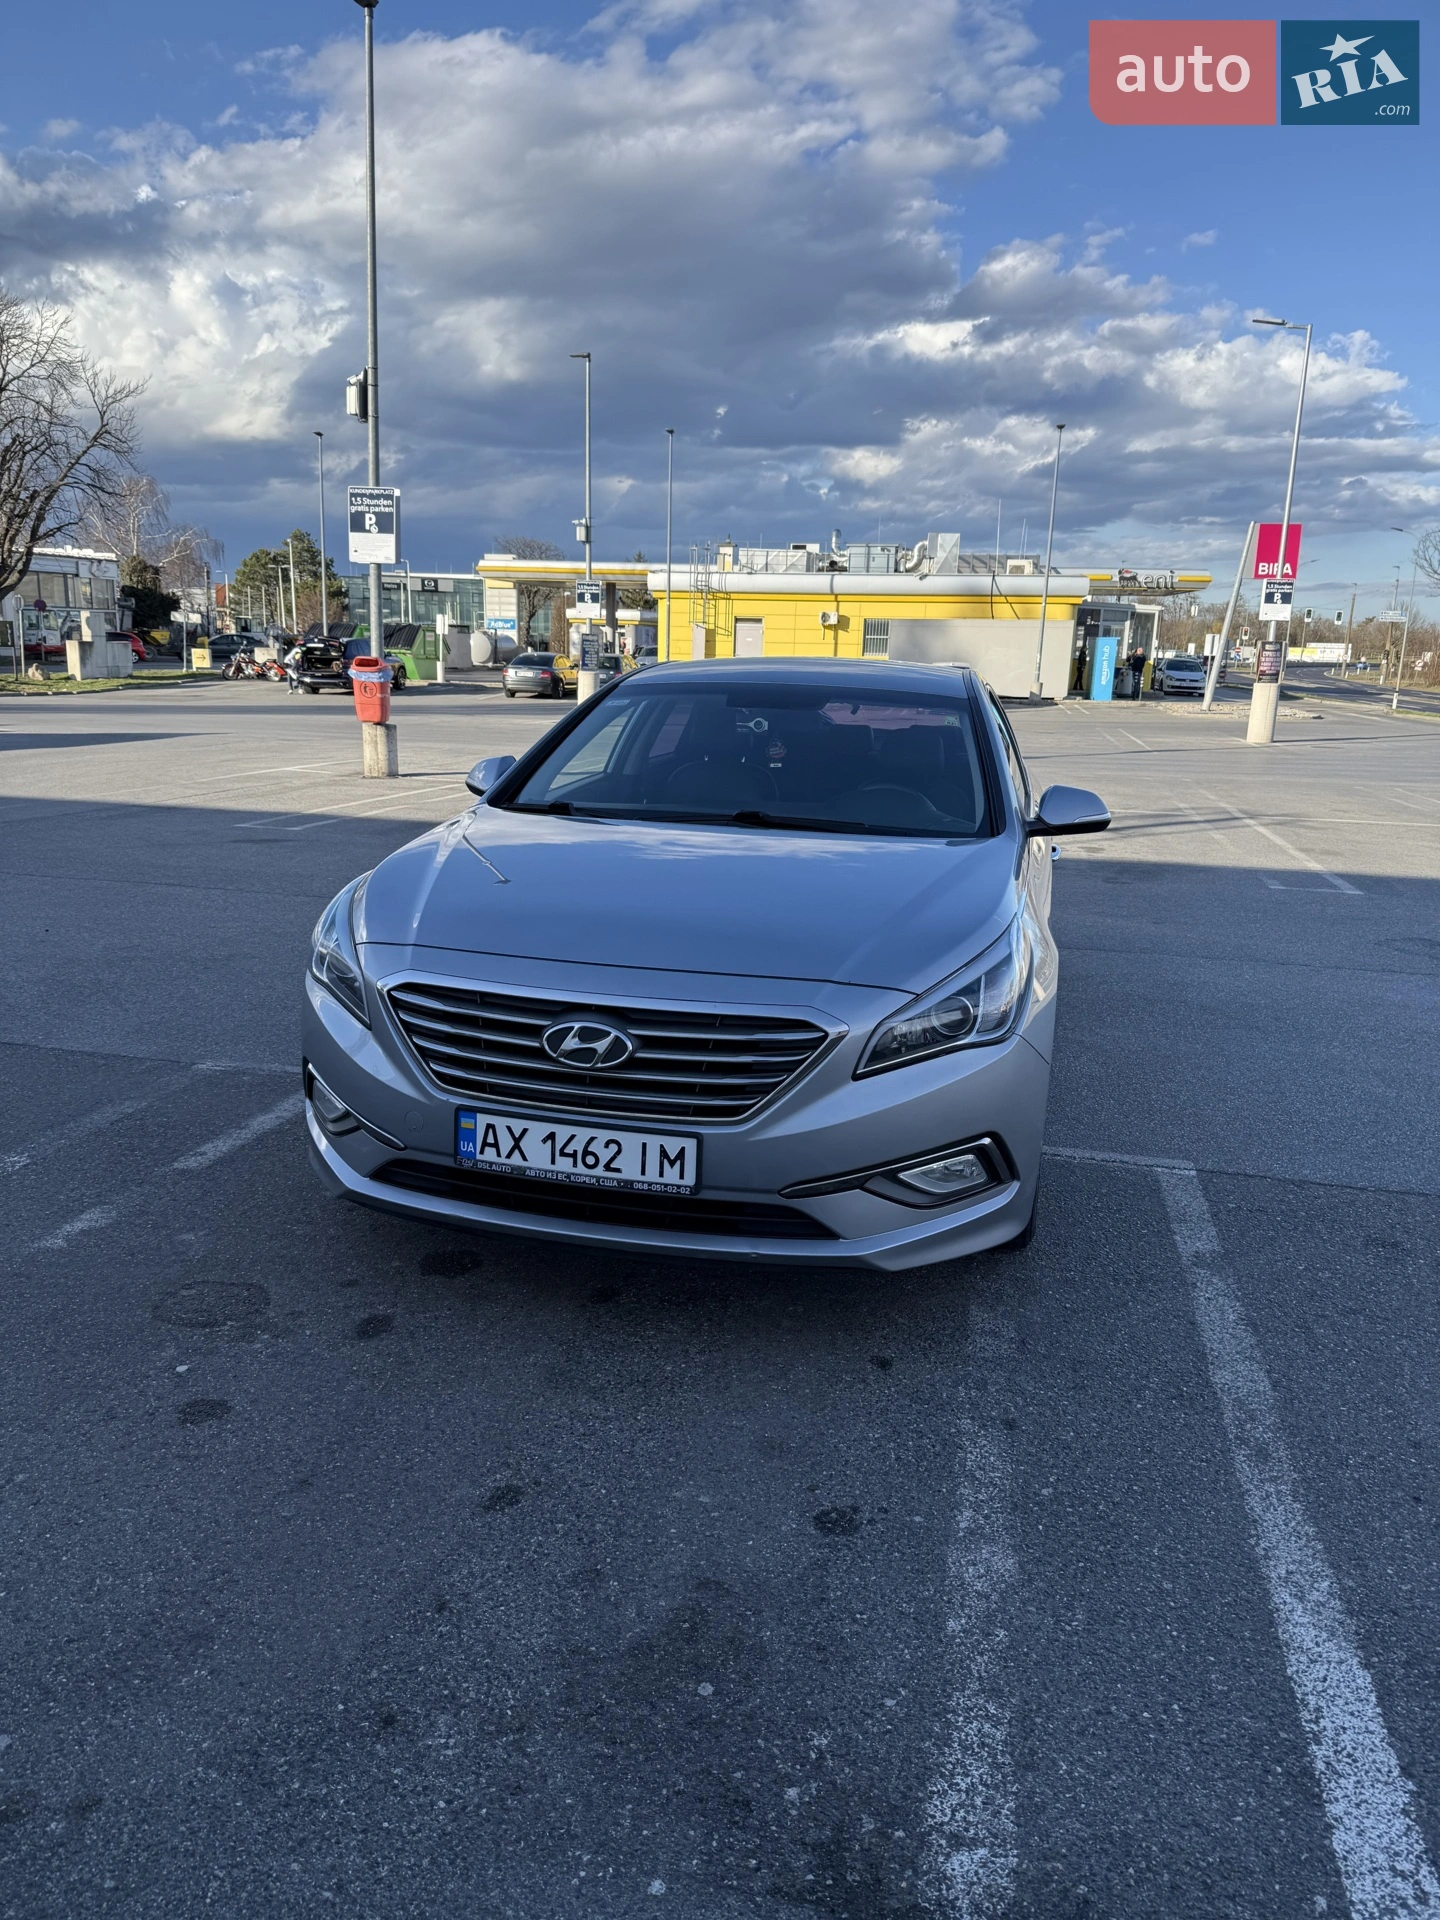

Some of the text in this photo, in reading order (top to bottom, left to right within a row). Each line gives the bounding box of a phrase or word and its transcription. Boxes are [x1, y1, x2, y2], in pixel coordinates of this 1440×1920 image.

[350, 505, 369, 513] gratis
[362, 498, 392, 506] Stunden
[365, 513, 376, 530] P
[1142, 570, 1175, 589] eni
[1101, 661, 1109, 685] amazon
[460, 1141, 475, 1153] UA
[479, 1122, 686, 1180] AX 1462 IM
[525, 1170, 545, 1178] АВТО
[570, 1174, 598, 1186] КОРЕИ,
[600, 1178, 618, 1187] США
[633, 1182, 690, 1194] 068-051-02-02
